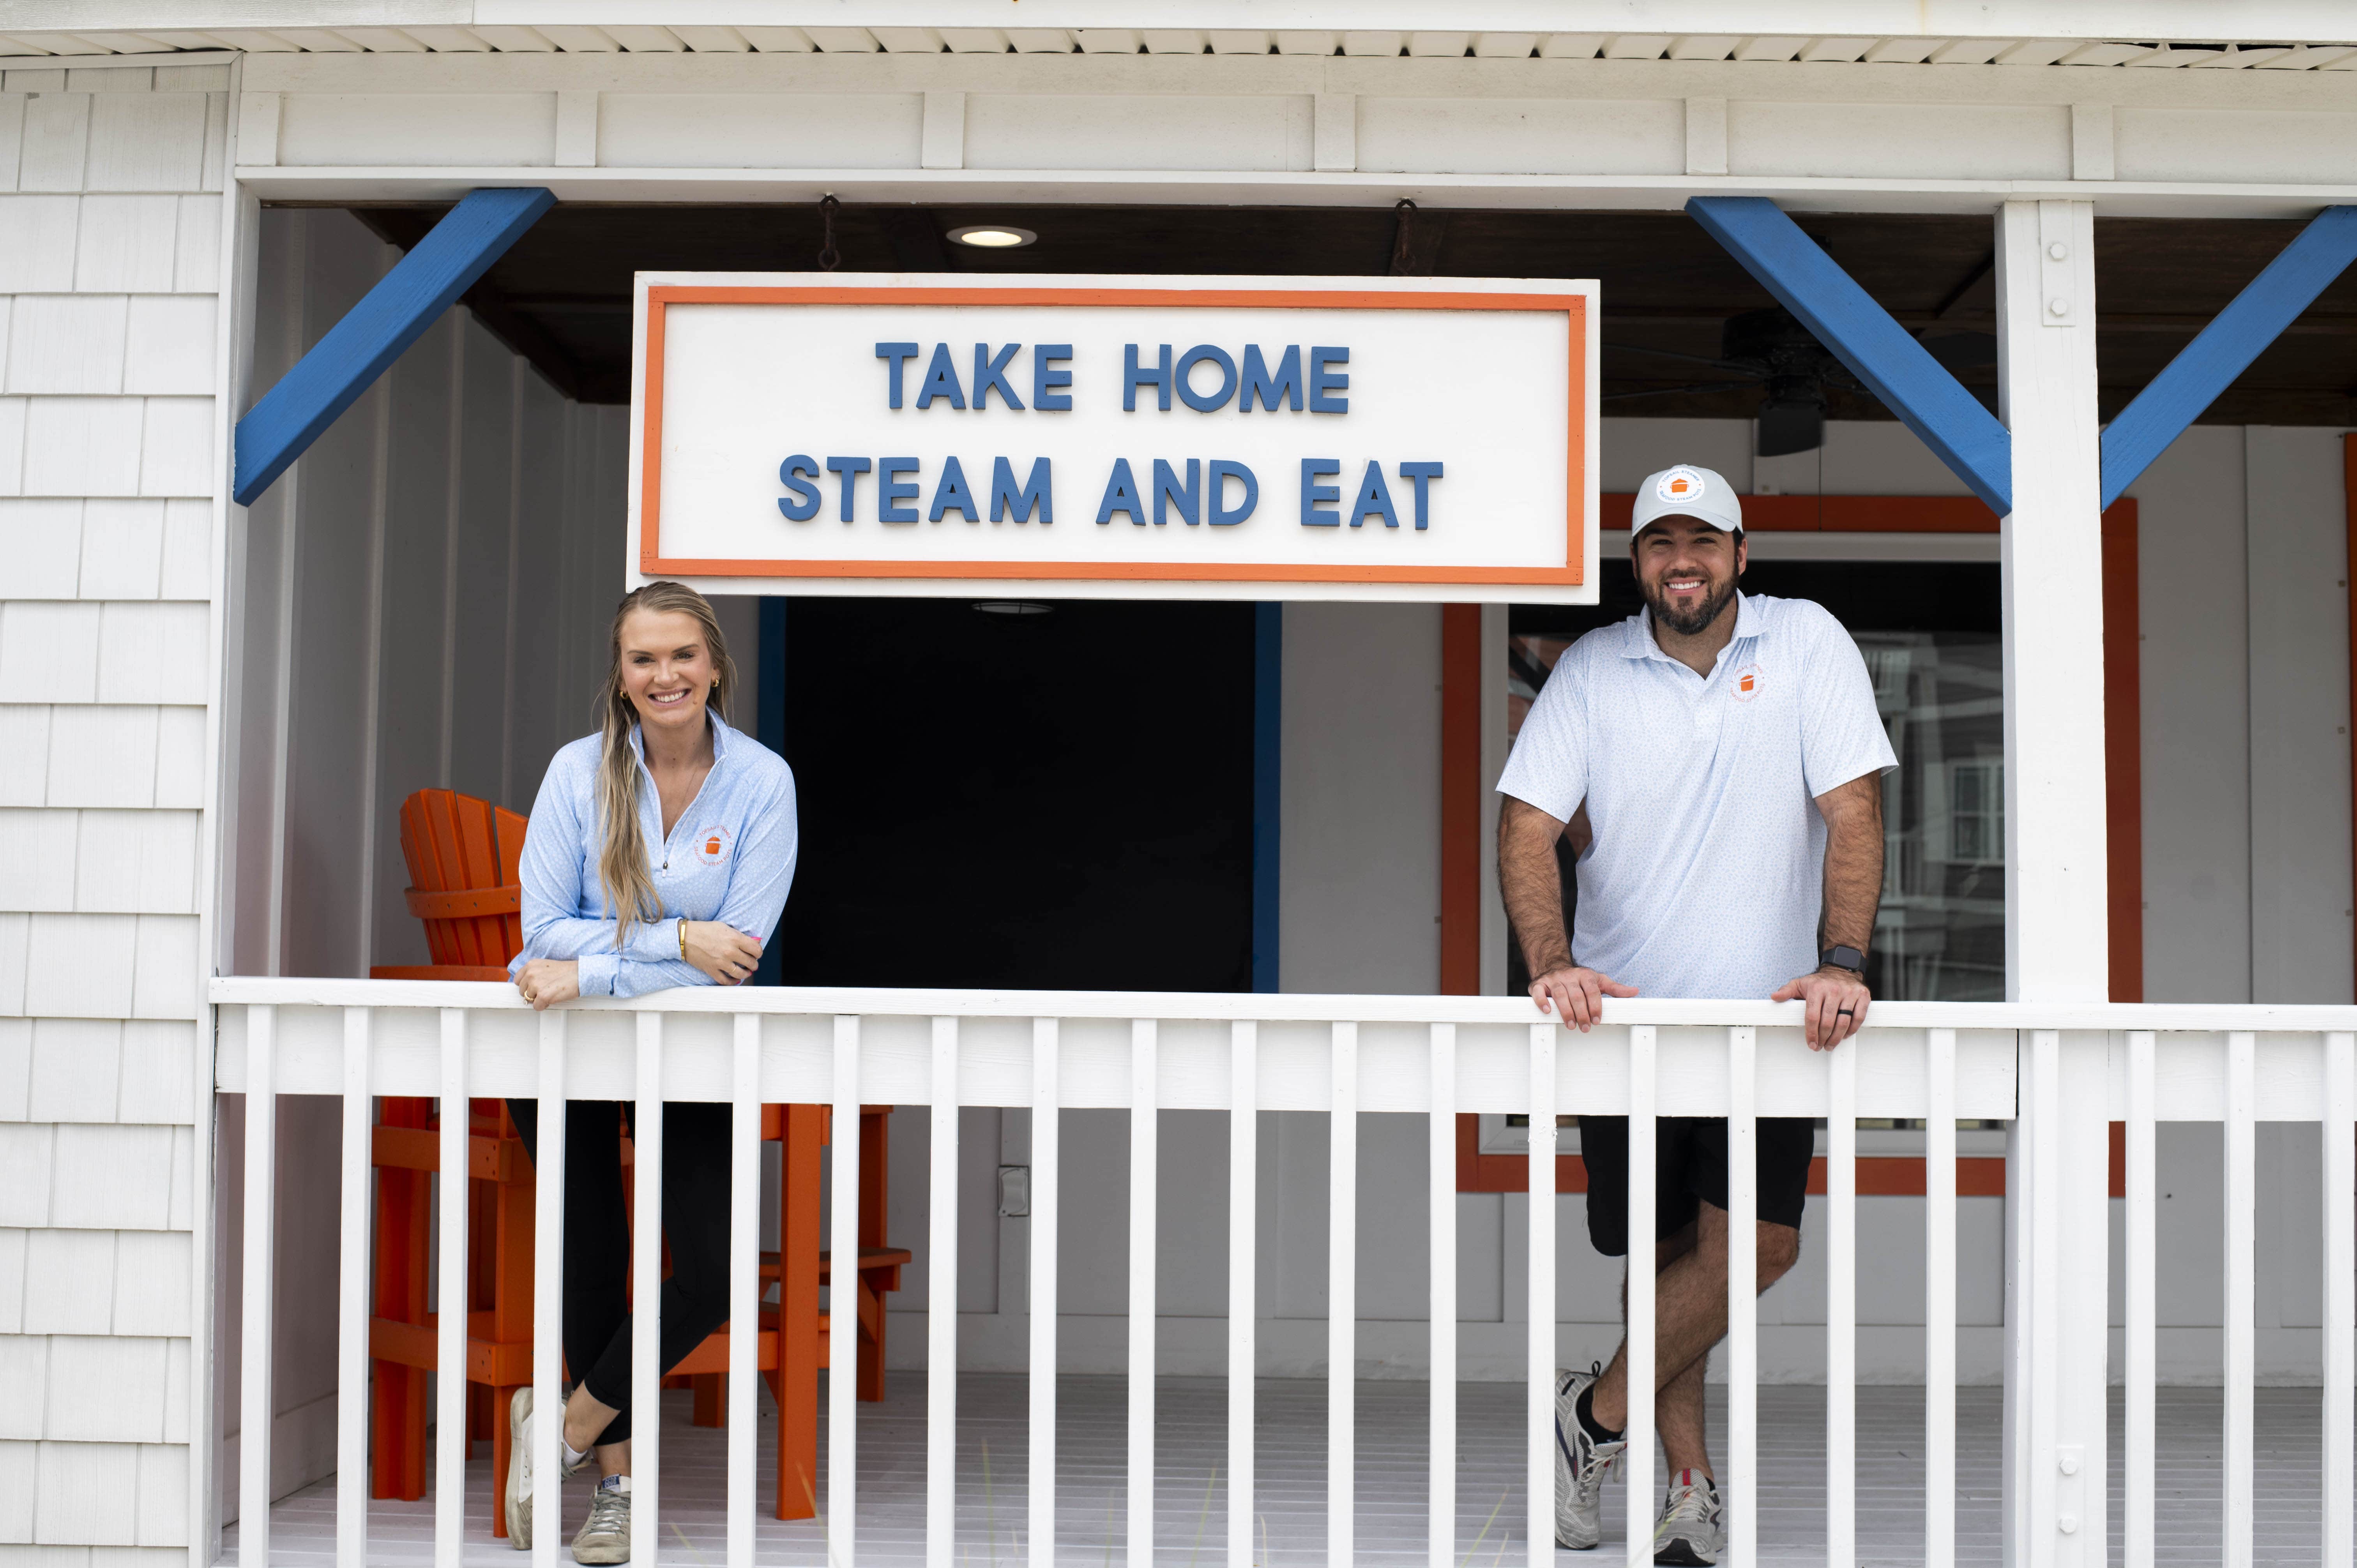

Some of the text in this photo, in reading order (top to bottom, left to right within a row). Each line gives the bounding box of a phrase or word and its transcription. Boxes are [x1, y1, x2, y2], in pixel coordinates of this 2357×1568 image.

[876, 343, 1349, 414] TAKE HOME
[1662, 470, 1700, 482] TOPSAIL STEAMER
[777, 454, 1444, 530] STEAM AND EAT
[1660, 490, 1675, 501] SEAFOOD
[1693, 488, 1701, 497] POTS
[1757, 683, 1765, 695] POTS
[699, 825, 731, 839] TOPSAIL STEAMER
[723, 849, 732, 861] POTS
